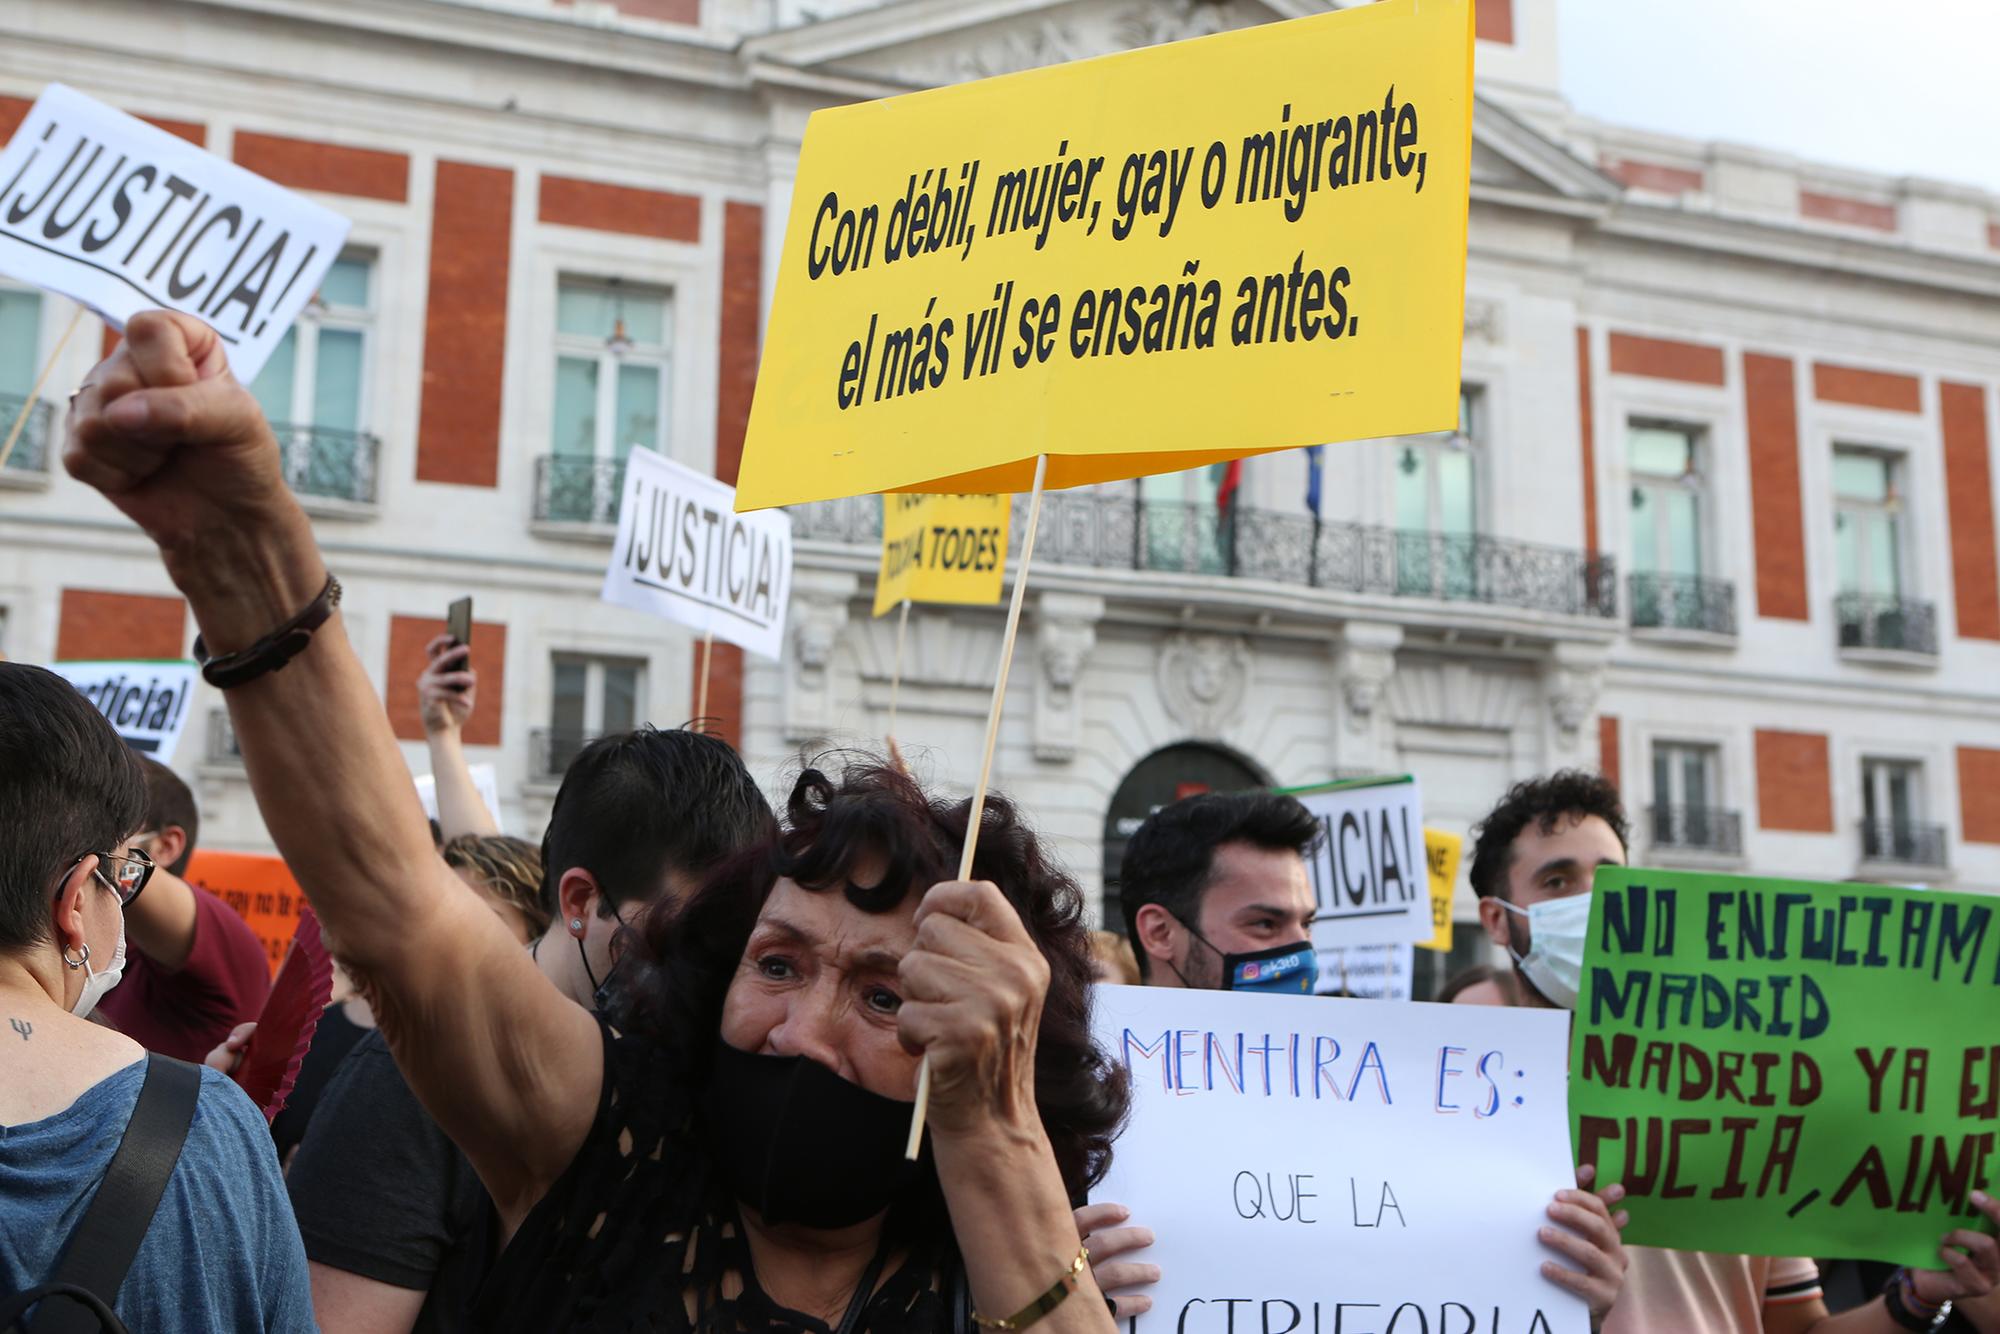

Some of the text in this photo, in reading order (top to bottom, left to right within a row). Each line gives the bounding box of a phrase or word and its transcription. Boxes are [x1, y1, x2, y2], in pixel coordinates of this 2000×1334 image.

[808, 83, 1427, 280] Con débil, mujer, gay o migrante,
[0, 121, 318, 338] ¡JUSTICIA!
[838, 250, 1358, 410] el más vil se ensaña antes.
[625, 479, 783, 622] ¡JUSTICIA!
[930, 527, 999, 570] TODES
[87, 675, 188, 732] ticia!
[1602, 886, 2000, 986] NO ENSUCIAM
[1590, 967, 1831, 1040] MADRID
[1435, 1046, 1525, 1119] ES:
[1582, 1033, 1823, 1107] MADRID
[1855, 1046, 1930, 1114] YA
[1233, 1170, 1407, 1228] QUE LA
[1830, 1132, 2000, 1218] ALME
